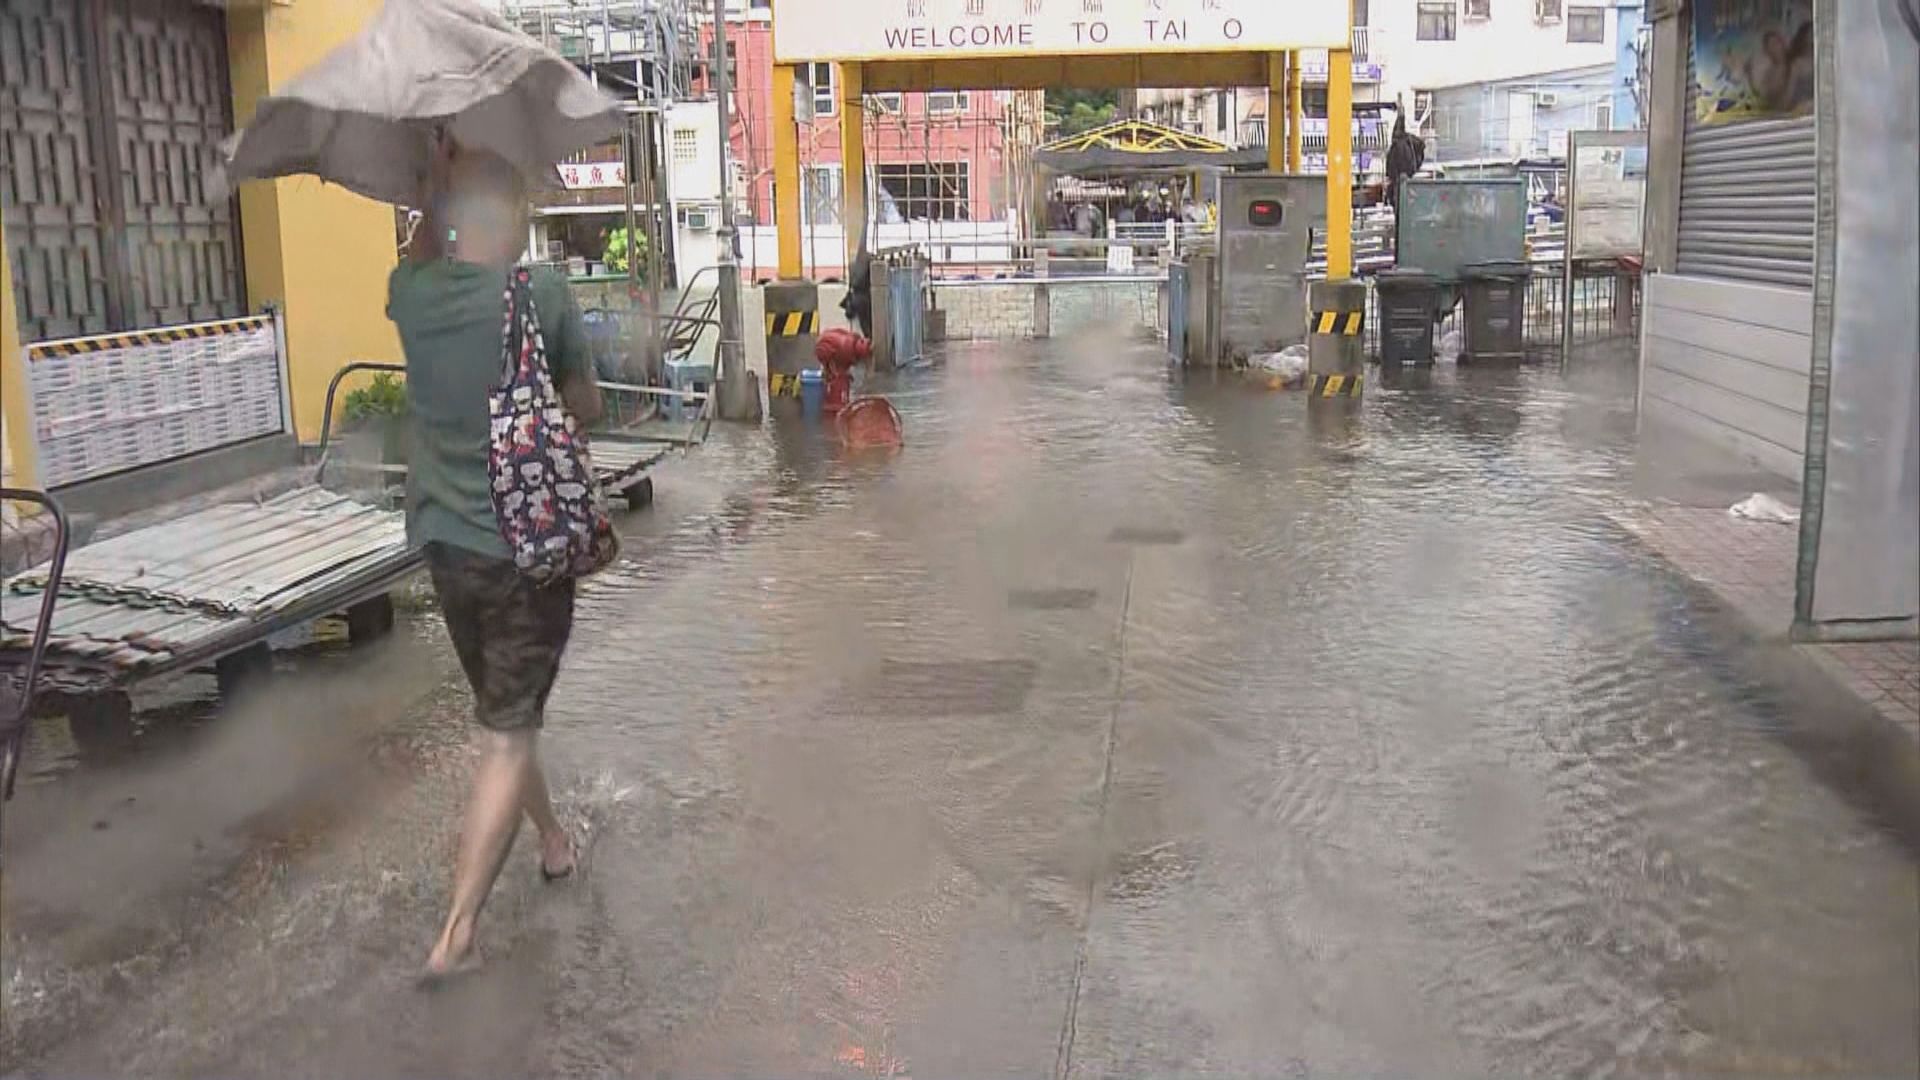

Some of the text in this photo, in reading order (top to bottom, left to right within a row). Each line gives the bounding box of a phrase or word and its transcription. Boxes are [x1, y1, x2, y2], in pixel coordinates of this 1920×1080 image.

[885, 18, 1243, 49] WELCOME TO TAI O
